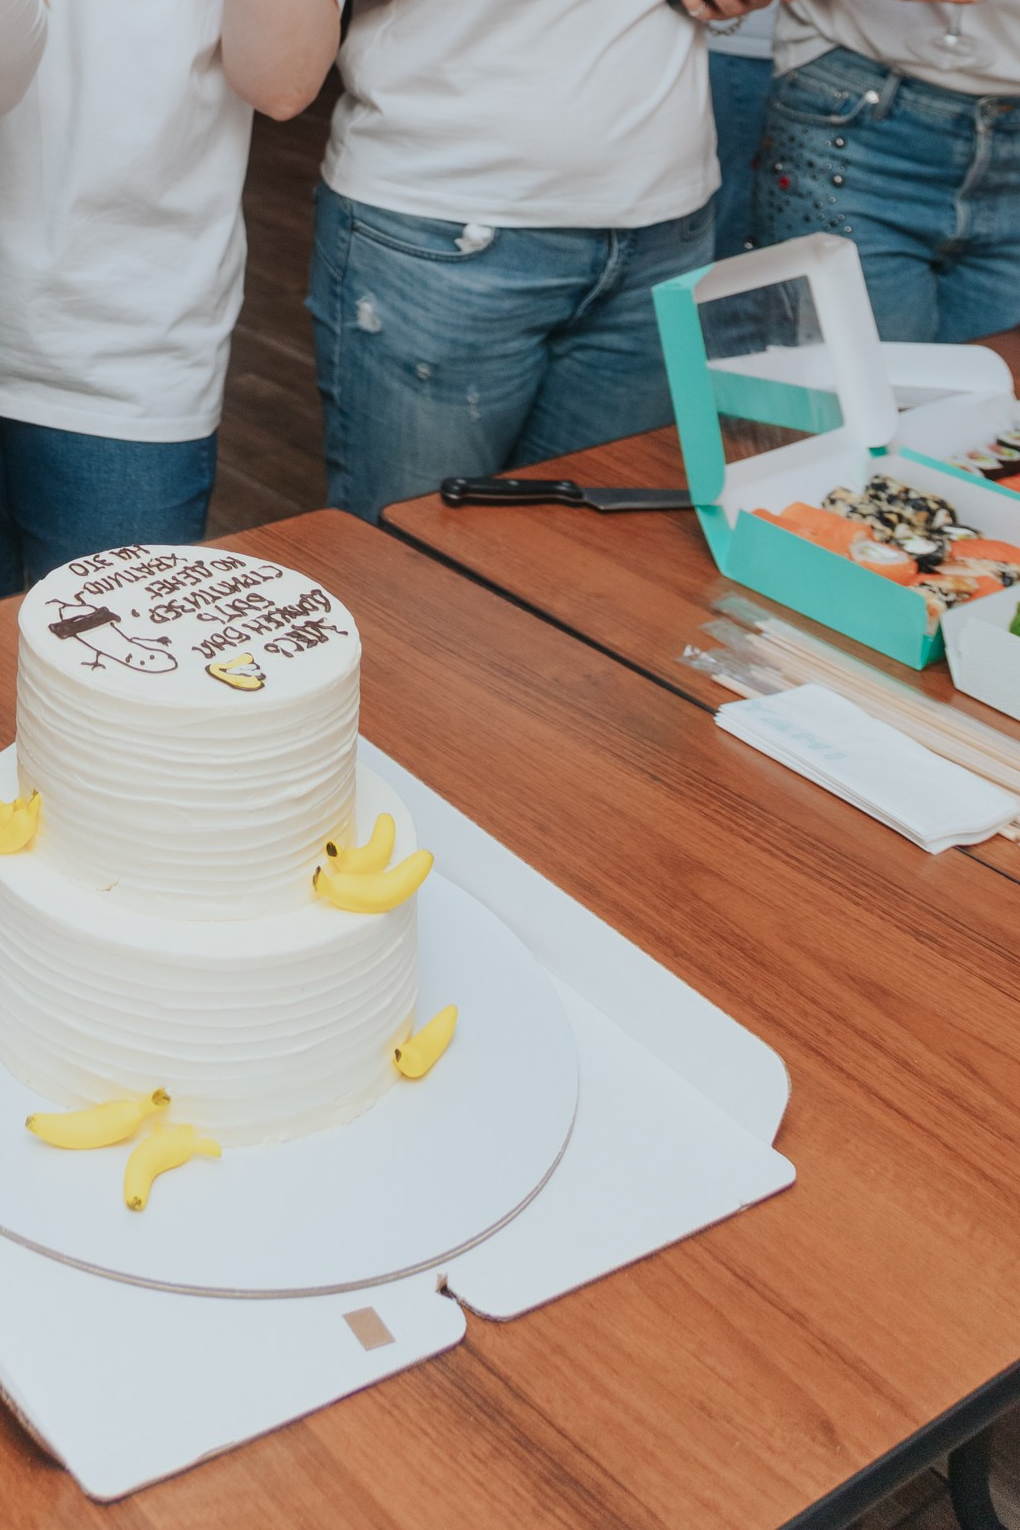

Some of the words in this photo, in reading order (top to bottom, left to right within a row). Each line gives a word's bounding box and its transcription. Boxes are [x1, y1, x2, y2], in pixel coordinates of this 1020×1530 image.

[68, 554, 114, 577] ЭТО
[108, 544, 150, 561] НА
[209, 556, 247, 572] НО
[82, 552, 188, 595] ХВАТИЛО
[144, 560, 213, 600] ДЕНЕГ
[196, 592, 276, 624] БЫТЬ
[191, 626, 251, 659] БЫЛ
